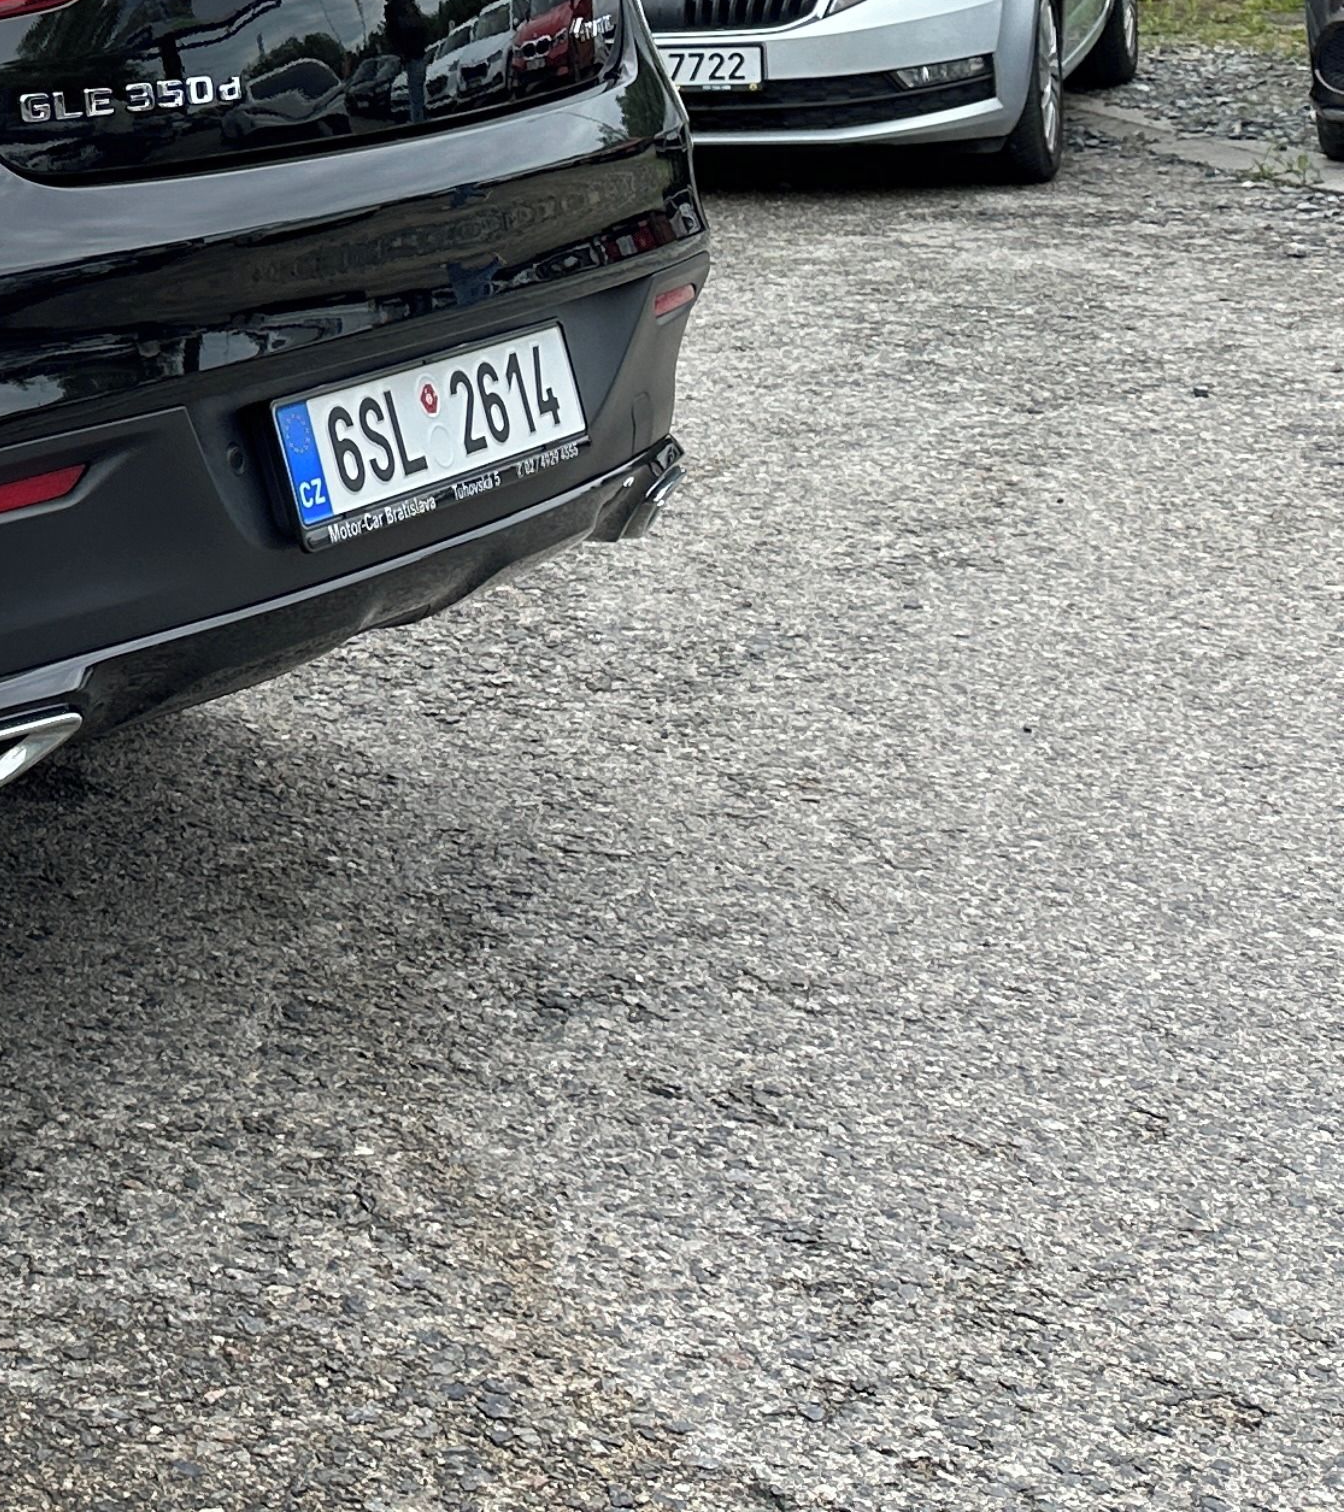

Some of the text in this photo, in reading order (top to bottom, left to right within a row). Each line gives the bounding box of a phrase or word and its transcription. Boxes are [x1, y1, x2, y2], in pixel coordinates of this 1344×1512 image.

[668, 52, 746, 82] 7722
[19, 75, 243, 124] GLE 350d
[327, 345, 561, 493] 6SL 2614
[298, 479, 327, 510] CZ
[327, 512, 383, 544] Motor-Car
[384, 496, 437, 525] Bratislava
